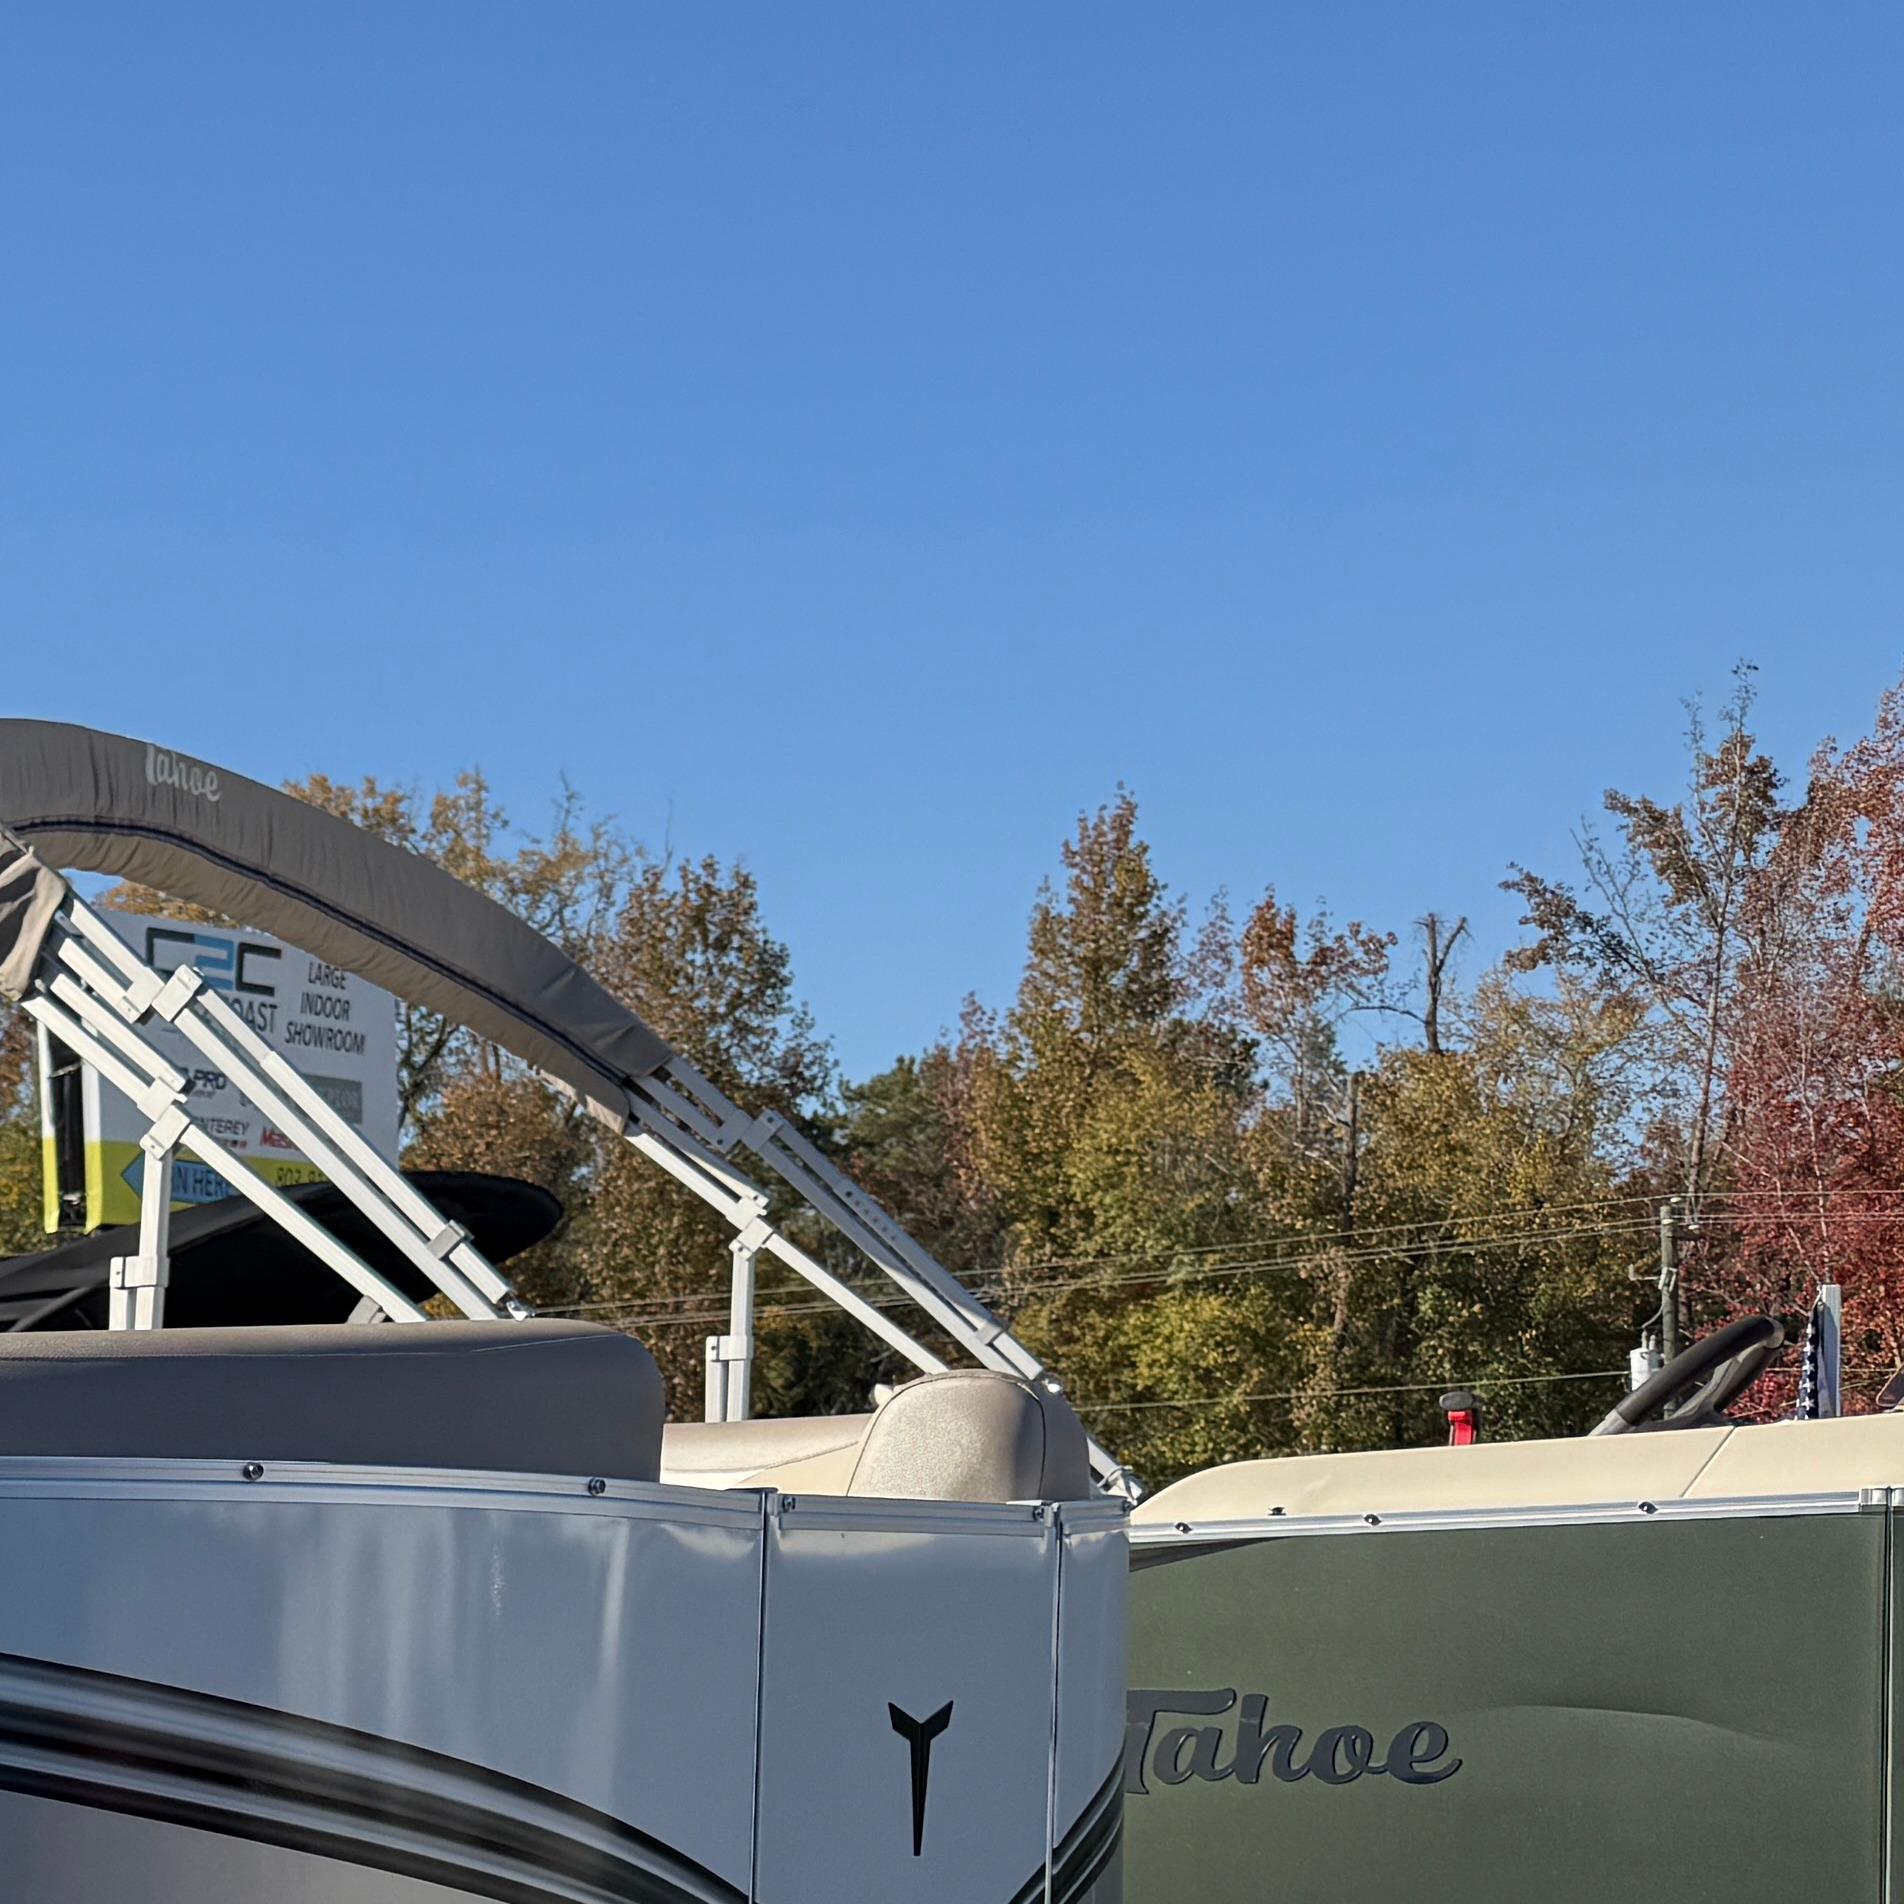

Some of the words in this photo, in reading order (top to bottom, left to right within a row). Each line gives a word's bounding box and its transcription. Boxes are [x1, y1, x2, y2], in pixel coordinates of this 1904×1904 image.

[308, 962, 346, 990] LARGE
[300, 992, 350, 1021] INDOOR
[1124, 1688, 1462, 1796] Tahoe
